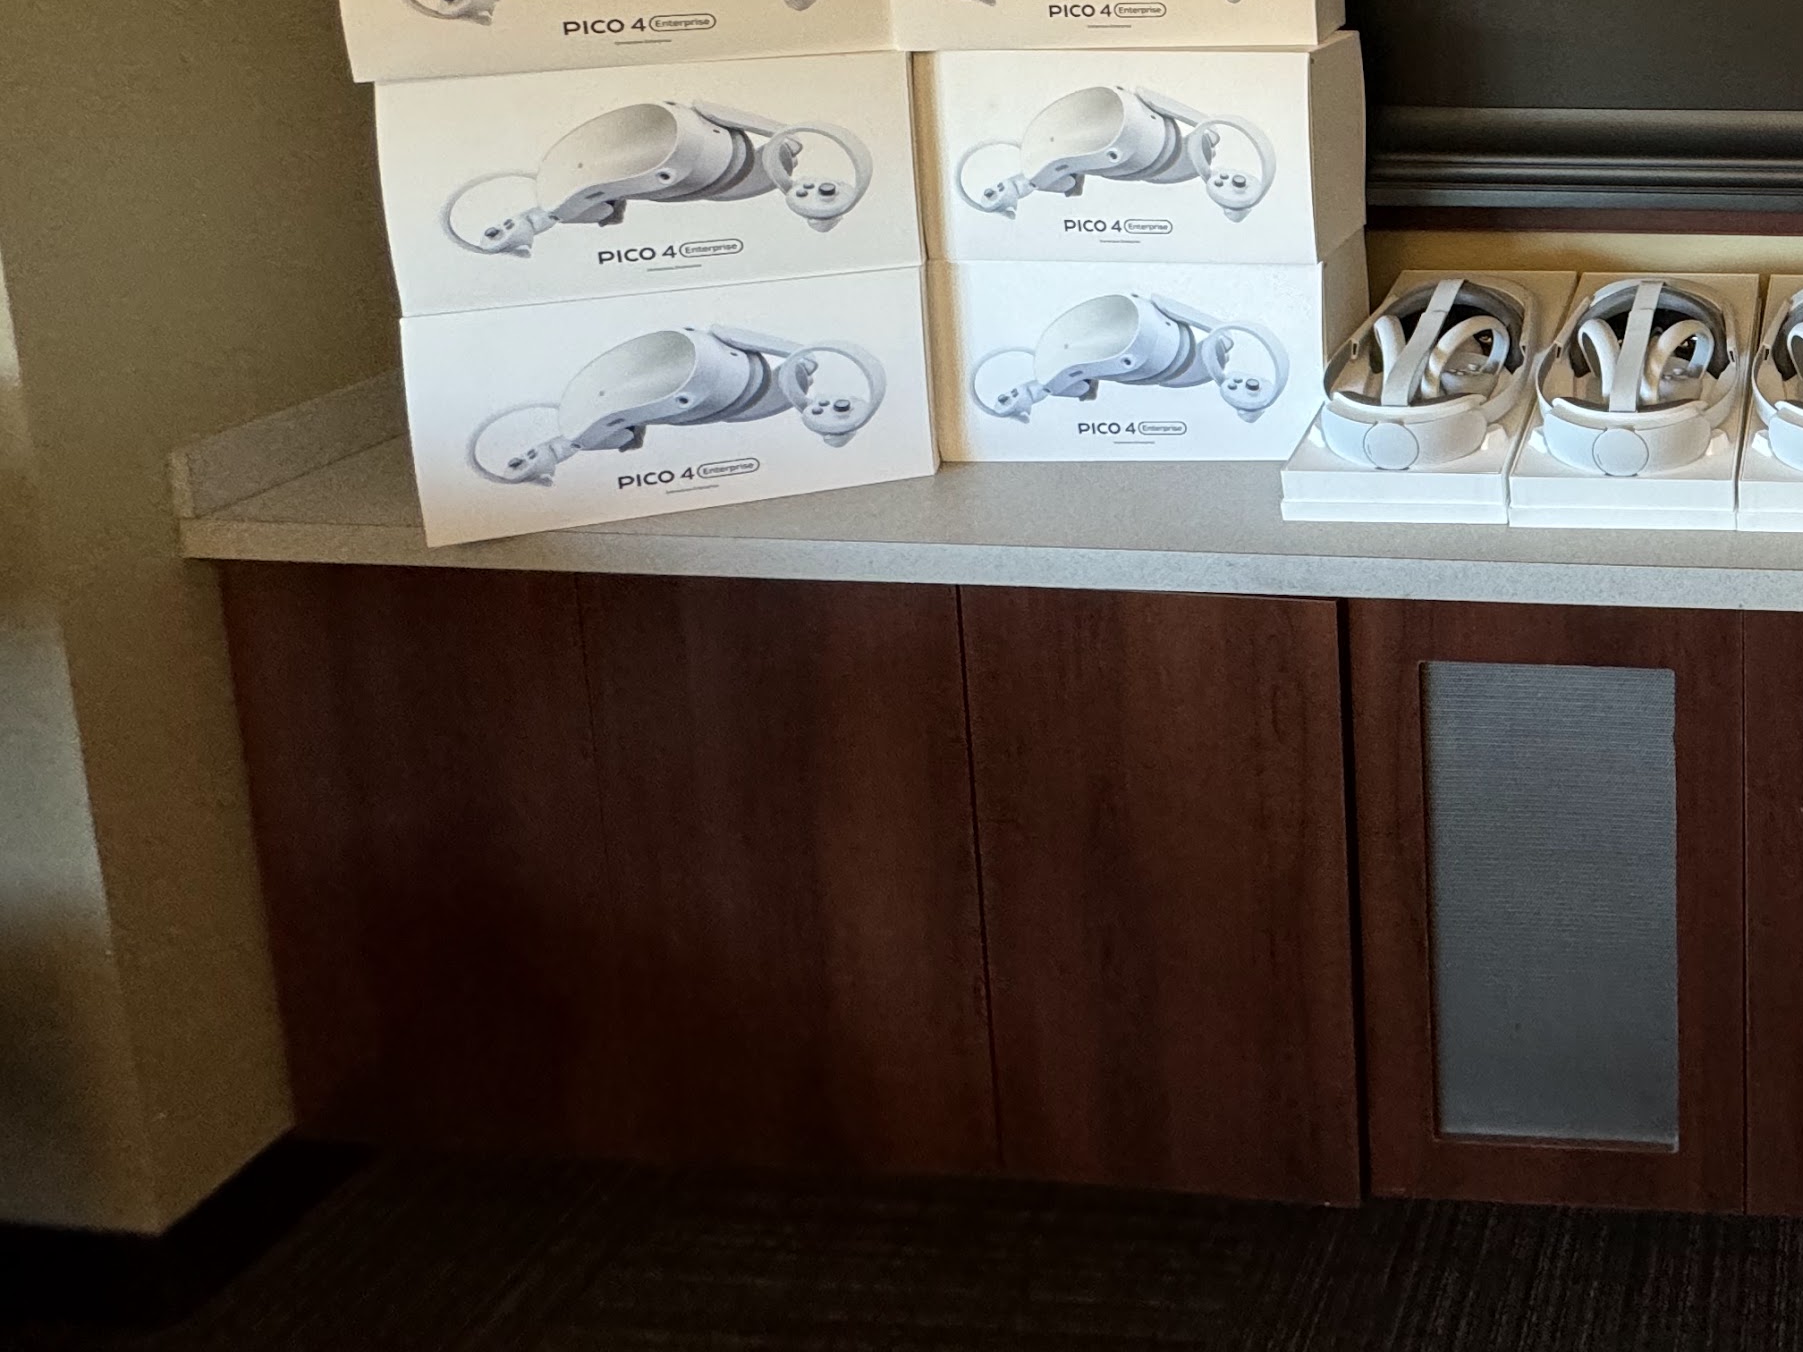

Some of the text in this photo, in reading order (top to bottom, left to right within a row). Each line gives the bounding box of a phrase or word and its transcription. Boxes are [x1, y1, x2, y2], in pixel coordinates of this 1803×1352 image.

[1048, 4, 1162, 18] PICO 4 Enterprise
[563, 17, 711, 36] PICO 4 Enterprise
[1063, 219, 1168, 233] PICO 4 Enterprise
[597, 243, 738, 265] PICO 4 Enterprise
[1077, 422, 1182, 435] PICO 4 Enterprise
[617, 470, 675, 490] PICO
[679, 467, 695, 480] 4
[702, 462, 755, 476] Enterprise
